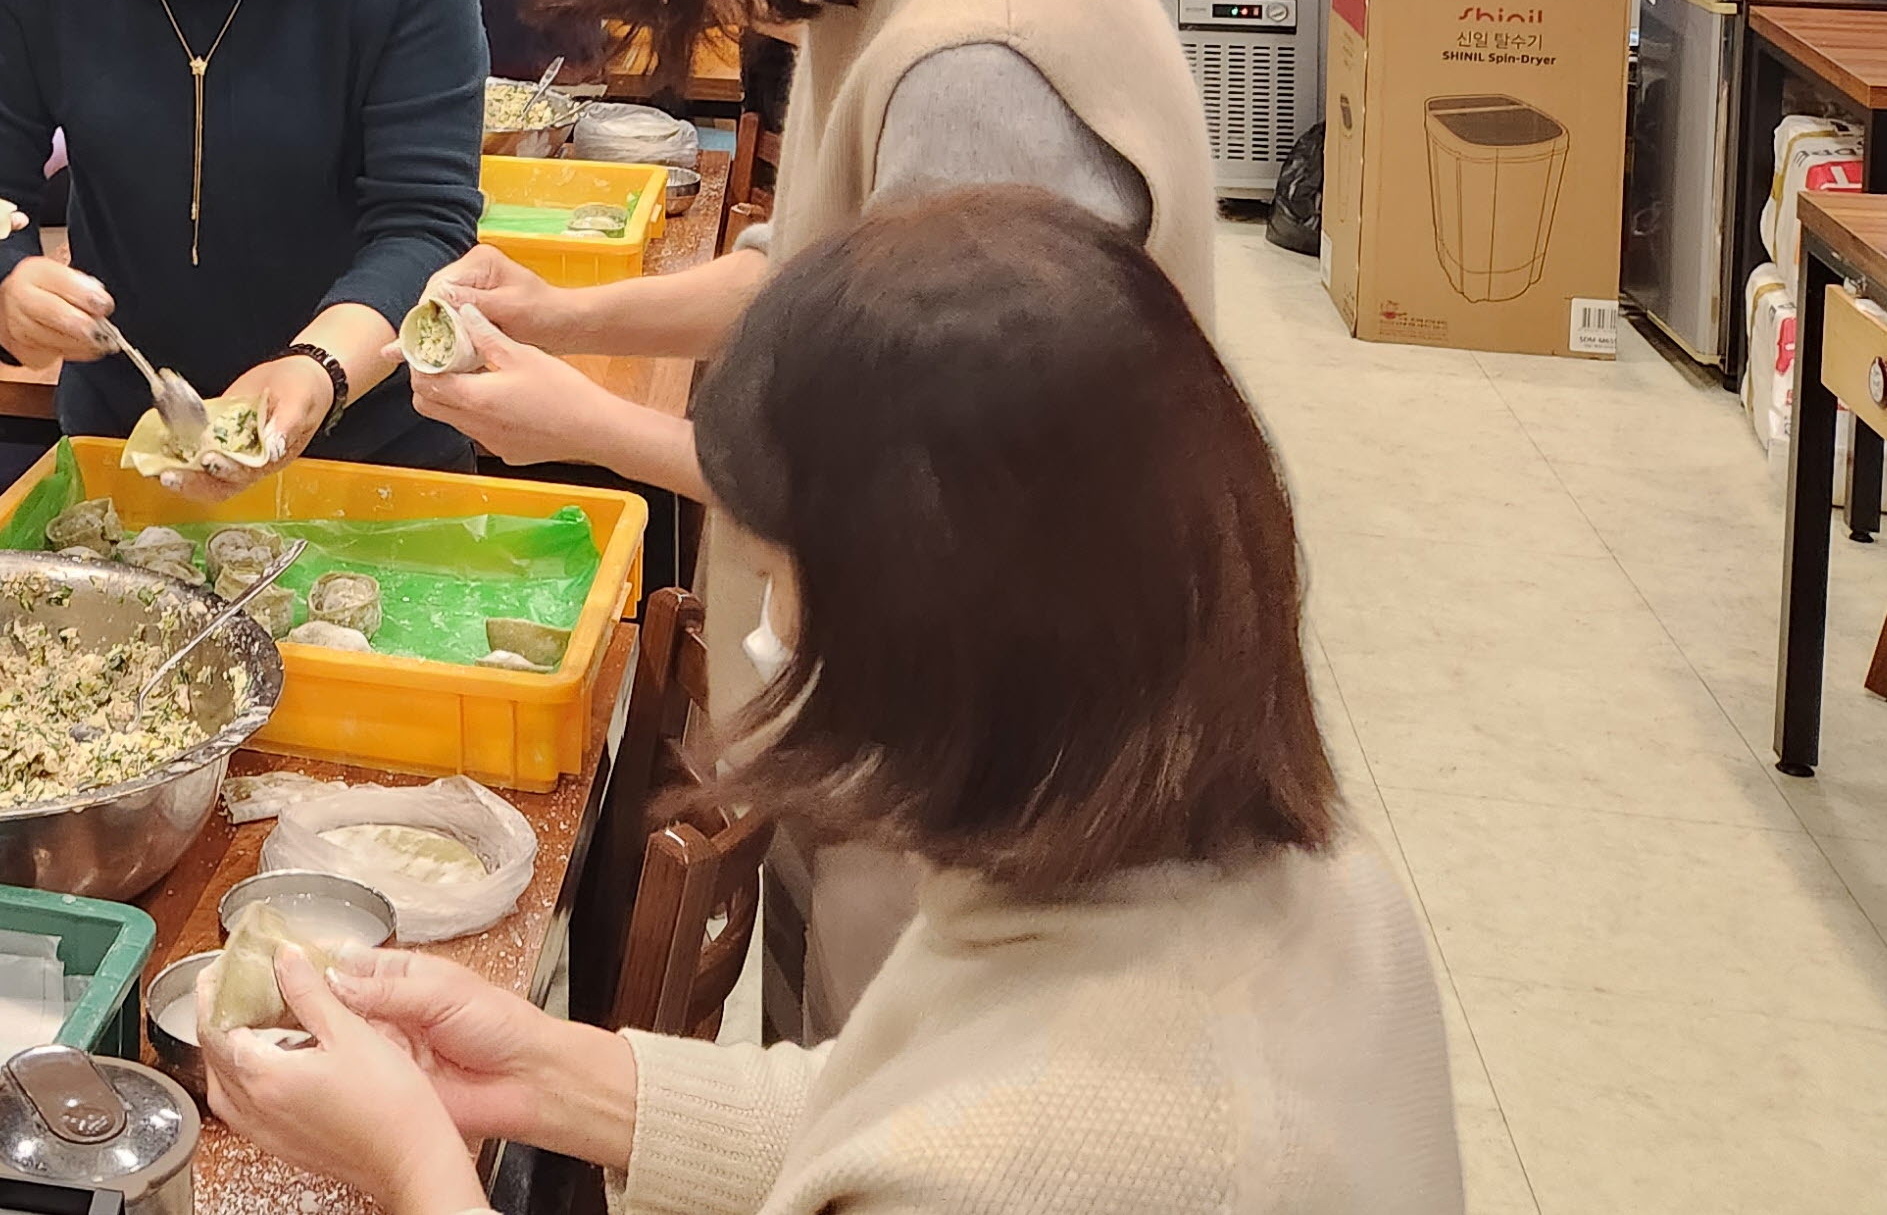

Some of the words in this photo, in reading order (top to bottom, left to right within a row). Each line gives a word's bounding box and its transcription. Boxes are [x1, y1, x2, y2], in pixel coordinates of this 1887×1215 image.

[1457, 30, 1489, 48] 신일
[1494, 32, 1543, 51] 탈수기
[1442, 50, 1485, 62] SHINIL
[1488, 52, 1557, 66] Spin-Dryer
